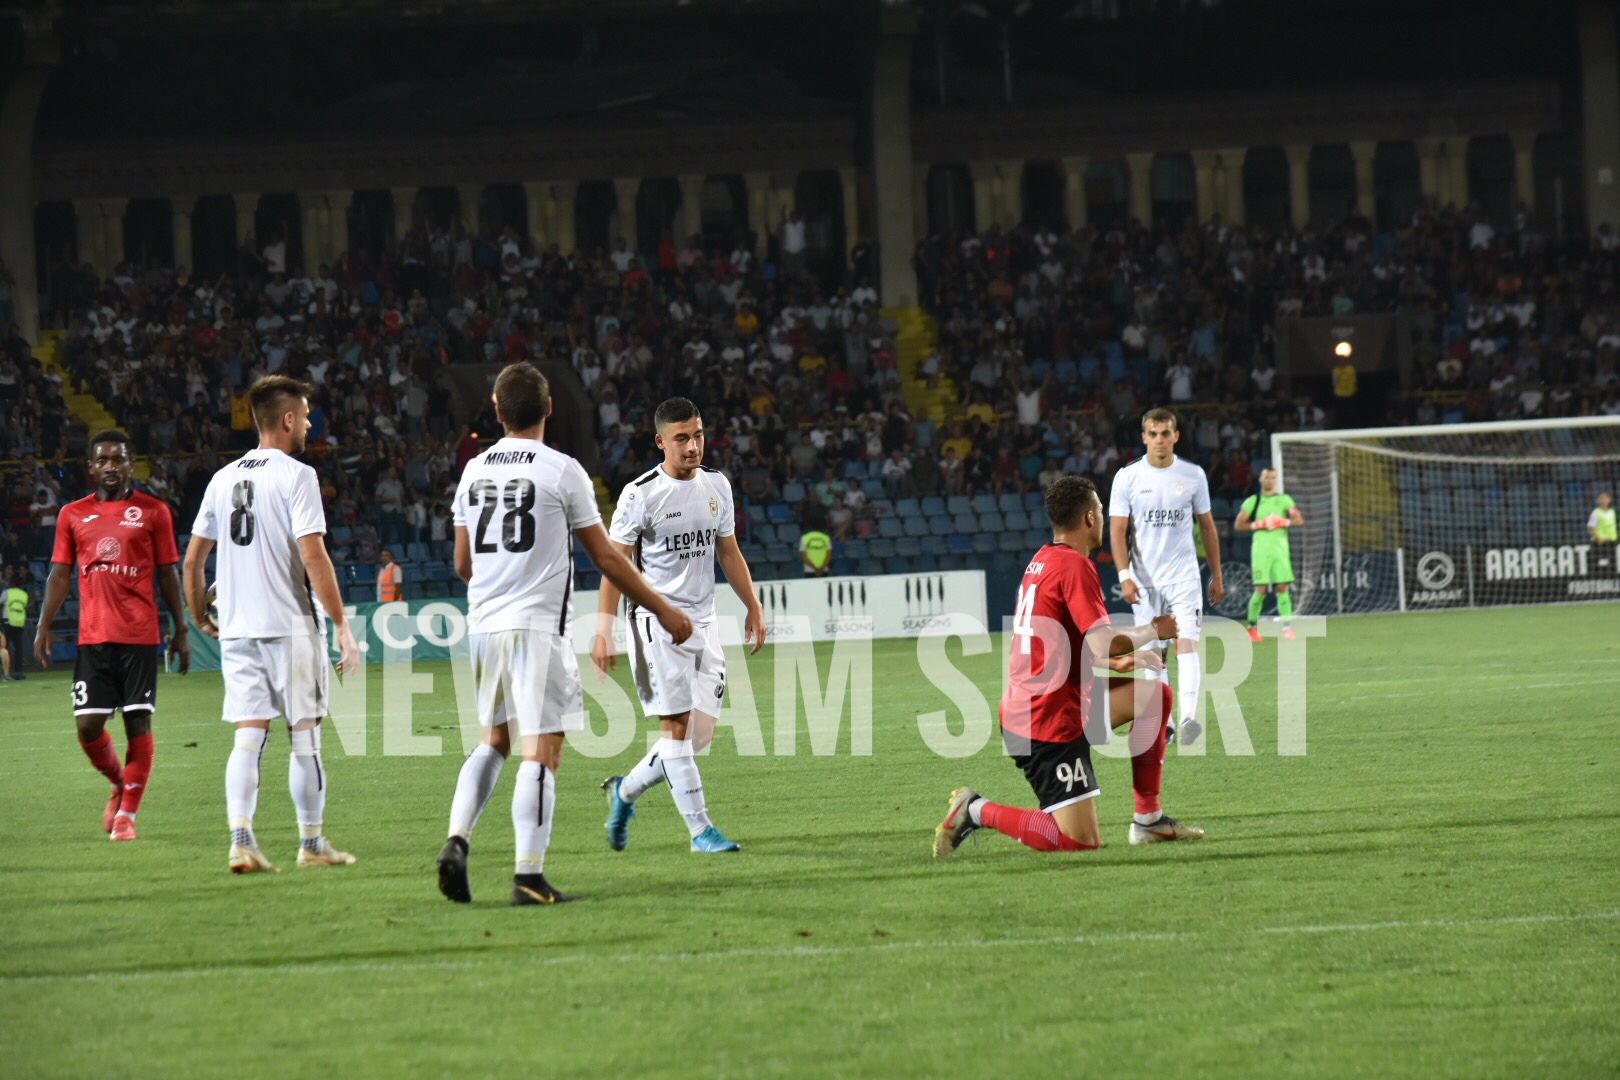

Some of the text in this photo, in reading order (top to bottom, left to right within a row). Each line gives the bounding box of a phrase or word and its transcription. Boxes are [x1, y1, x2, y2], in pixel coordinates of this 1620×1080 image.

[484, 451, 536, 465] MORREN
[230, 480, 255, 546] 8
[468, 477, 536, 554] 28
[665, 511, 682, 519] JAKO
[1143, 509, 1185, 523] LEOPARD
[1485, 544, 1591, 581] ARARAT
[1411, 589, 1463, 603] ARARAT
[902, 616, 953, 630] SEASONS
[1011, 583, 1036, 655] 4
[824, 621, 875, 634] SEASONS
[1056, 757, 1088, 793] 94
